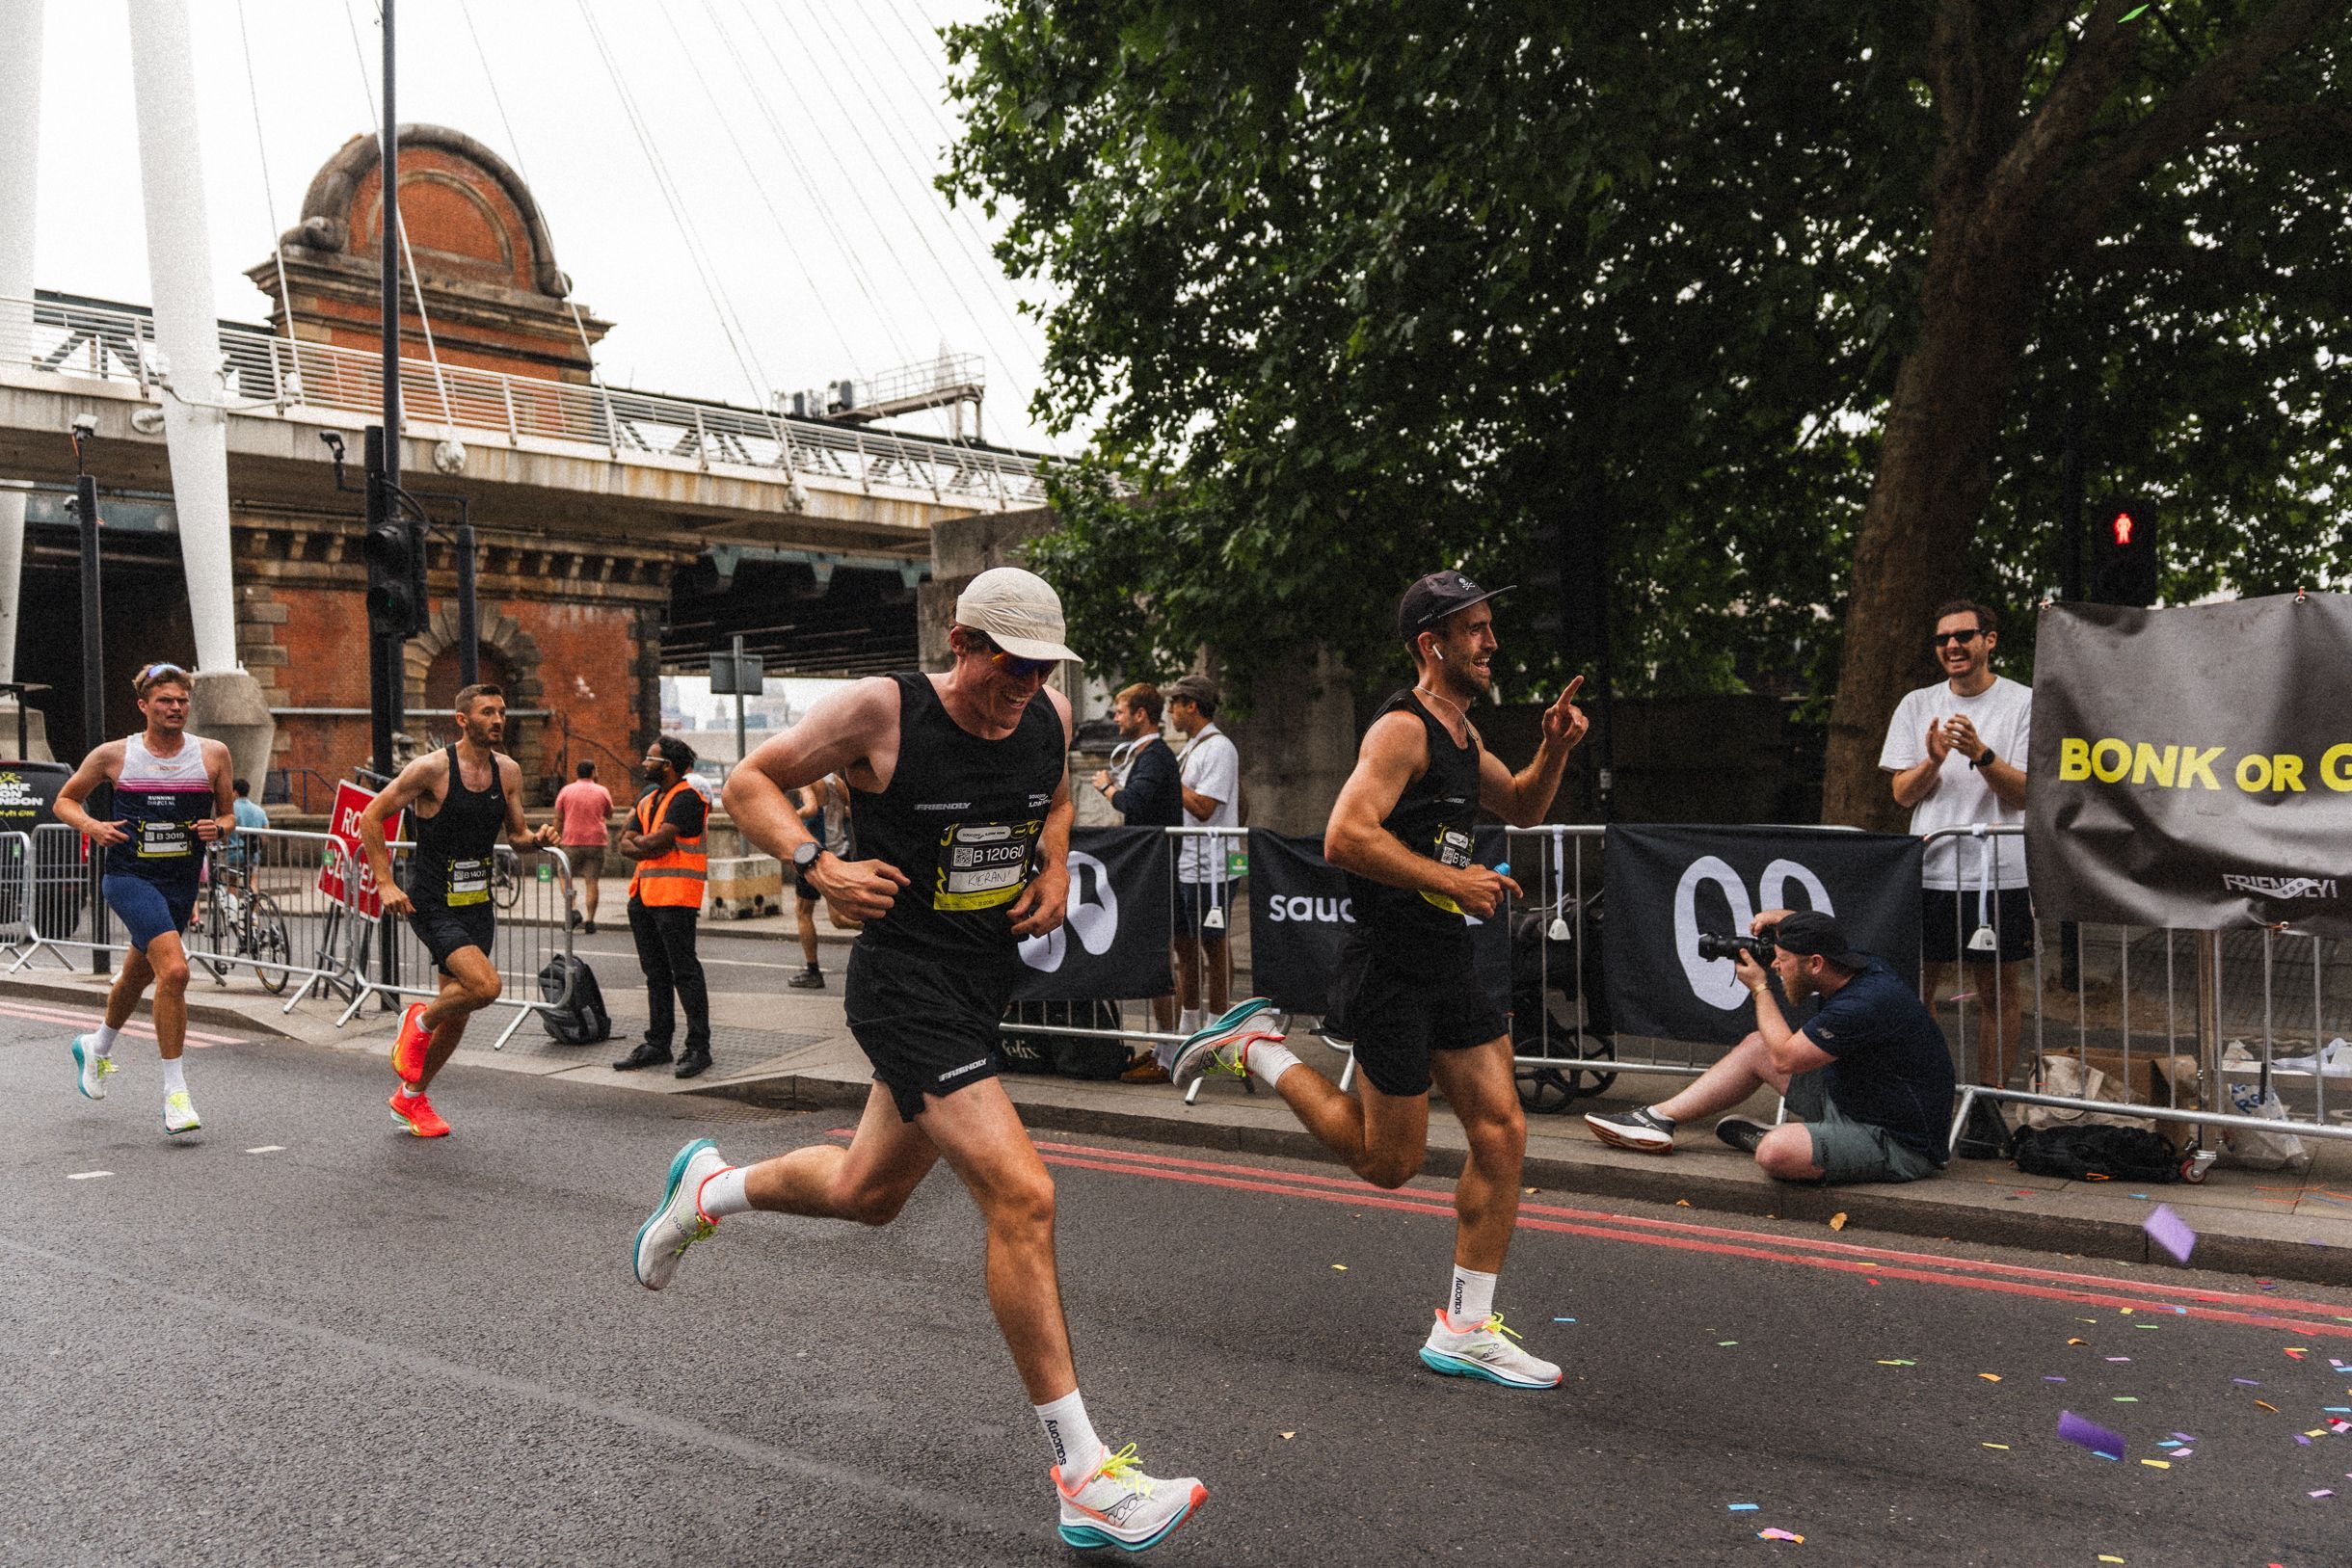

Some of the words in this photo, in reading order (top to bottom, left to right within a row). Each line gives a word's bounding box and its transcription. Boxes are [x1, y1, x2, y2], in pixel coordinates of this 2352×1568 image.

[2059, 738, 2226, 790] BONK
[2235, 755, 2307, 792] OR
[0, 783, 31, 791] AKE
[0, 797, 43, 806] NDON
[915, 802, 972, 811] FRIENDLY
[340, 807, 363, 839] RO
[166, 832, 185, 840] 3019
[974, 850, 983, 864] B
[986, 844, 1025, 862] 12060
[1453, 853, 1459, 864] B
[1269, 894, 1356, 922] sauc
[939, 1057, 987, 1082] FRIENDLY
[1455, 1277, 1466, 1315] saucony
[1045, 1420, 1066, 1466] saucony
